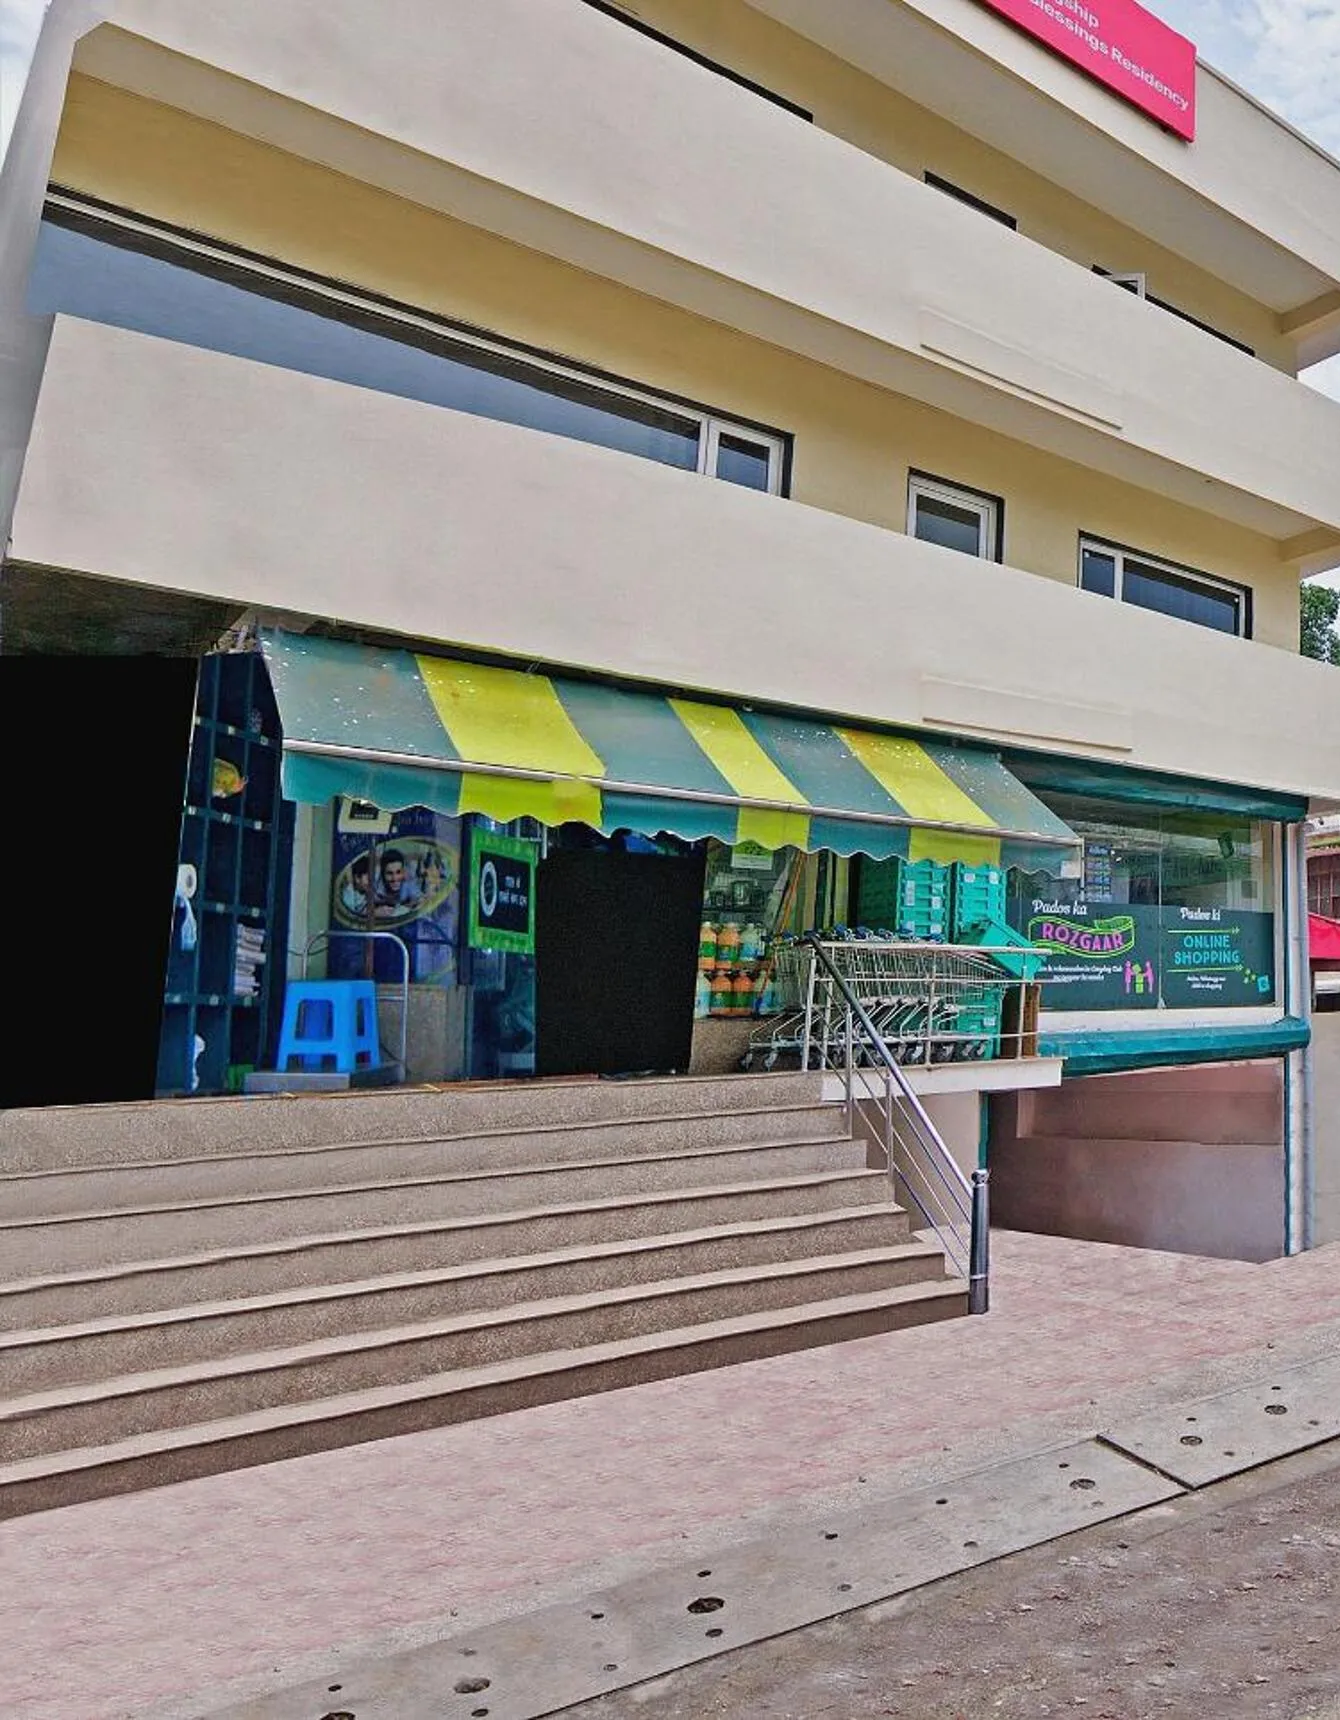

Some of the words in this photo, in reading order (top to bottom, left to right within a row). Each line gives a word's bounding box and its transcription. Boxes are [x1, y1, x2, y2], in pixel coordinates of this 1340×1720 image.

[1110, 45, 1189, 111] Residency
[1032, 899, 1071, 914] Pados
[1072, 900, 1088, 916] ka
[1041, 922, 1124, 951] ROZGAAR
[1183, 935, 1231, 948] ONLINE
[1174, 950, 1241, 965] SHOPPING
